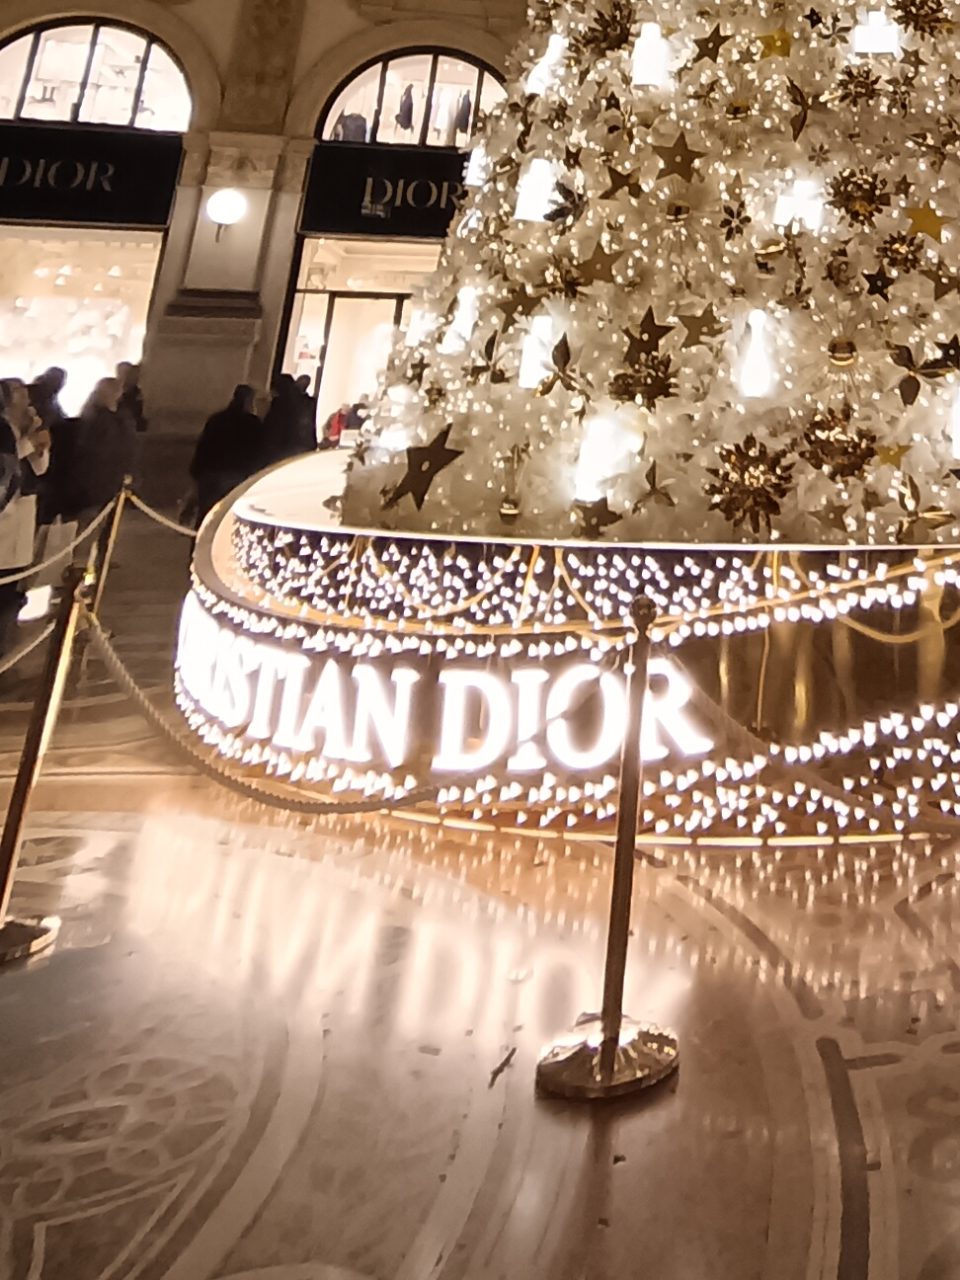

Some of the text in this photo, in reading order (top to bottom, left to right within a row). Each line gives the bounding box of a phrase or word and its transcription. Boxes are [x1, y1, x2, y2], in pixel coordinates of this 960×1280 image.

[0, 157, 115, 192] DIOR
[361, 177, 463, 209] DIOR
[431, 657, 715, 771] DIOR
